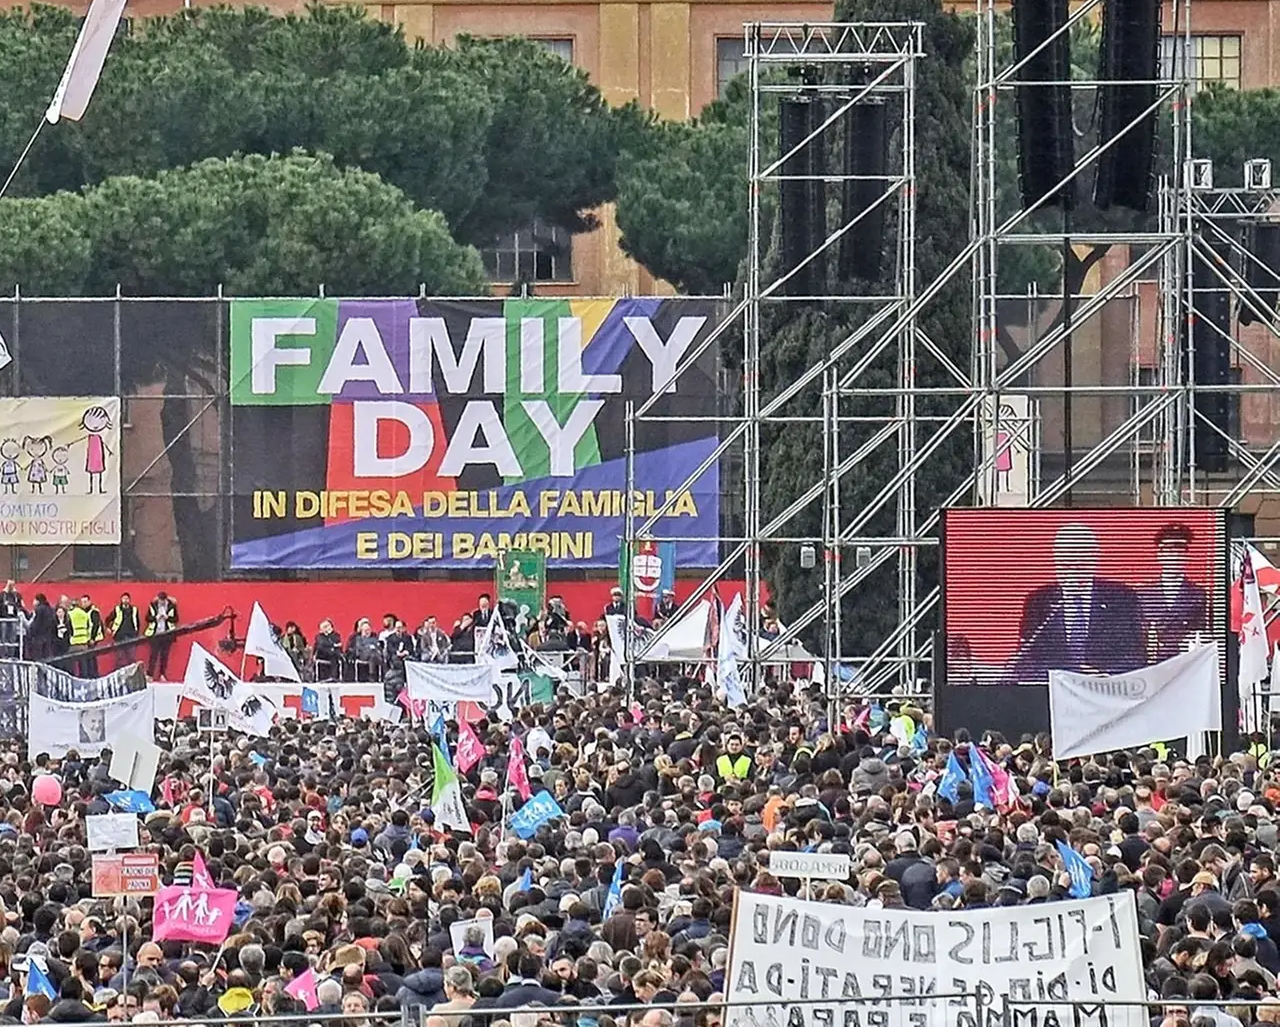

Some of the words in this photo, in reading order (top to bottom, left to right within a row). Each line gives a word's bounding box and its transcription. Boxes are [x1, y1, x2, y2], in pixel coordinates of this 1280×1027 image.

[249, 316, 707, 397] FAMILY
[352, 400, 605, 478] DAY
[252, 490, 287, 517] IN
[296, 490, 415, 517] DIFESA
[423, 490, 522, 517] DELLA
[531, 489, 697, 517] FAMIGLIA
[21, 522, 25, 533] I
[28, 521, 77, 535] NOSTRI
[80, 520, 115, 535] FIGLI
[357, 532, 376, 557] E
[387, 532, 438, 557] DEI
[452, 532, 592, 557] BAMBINI
